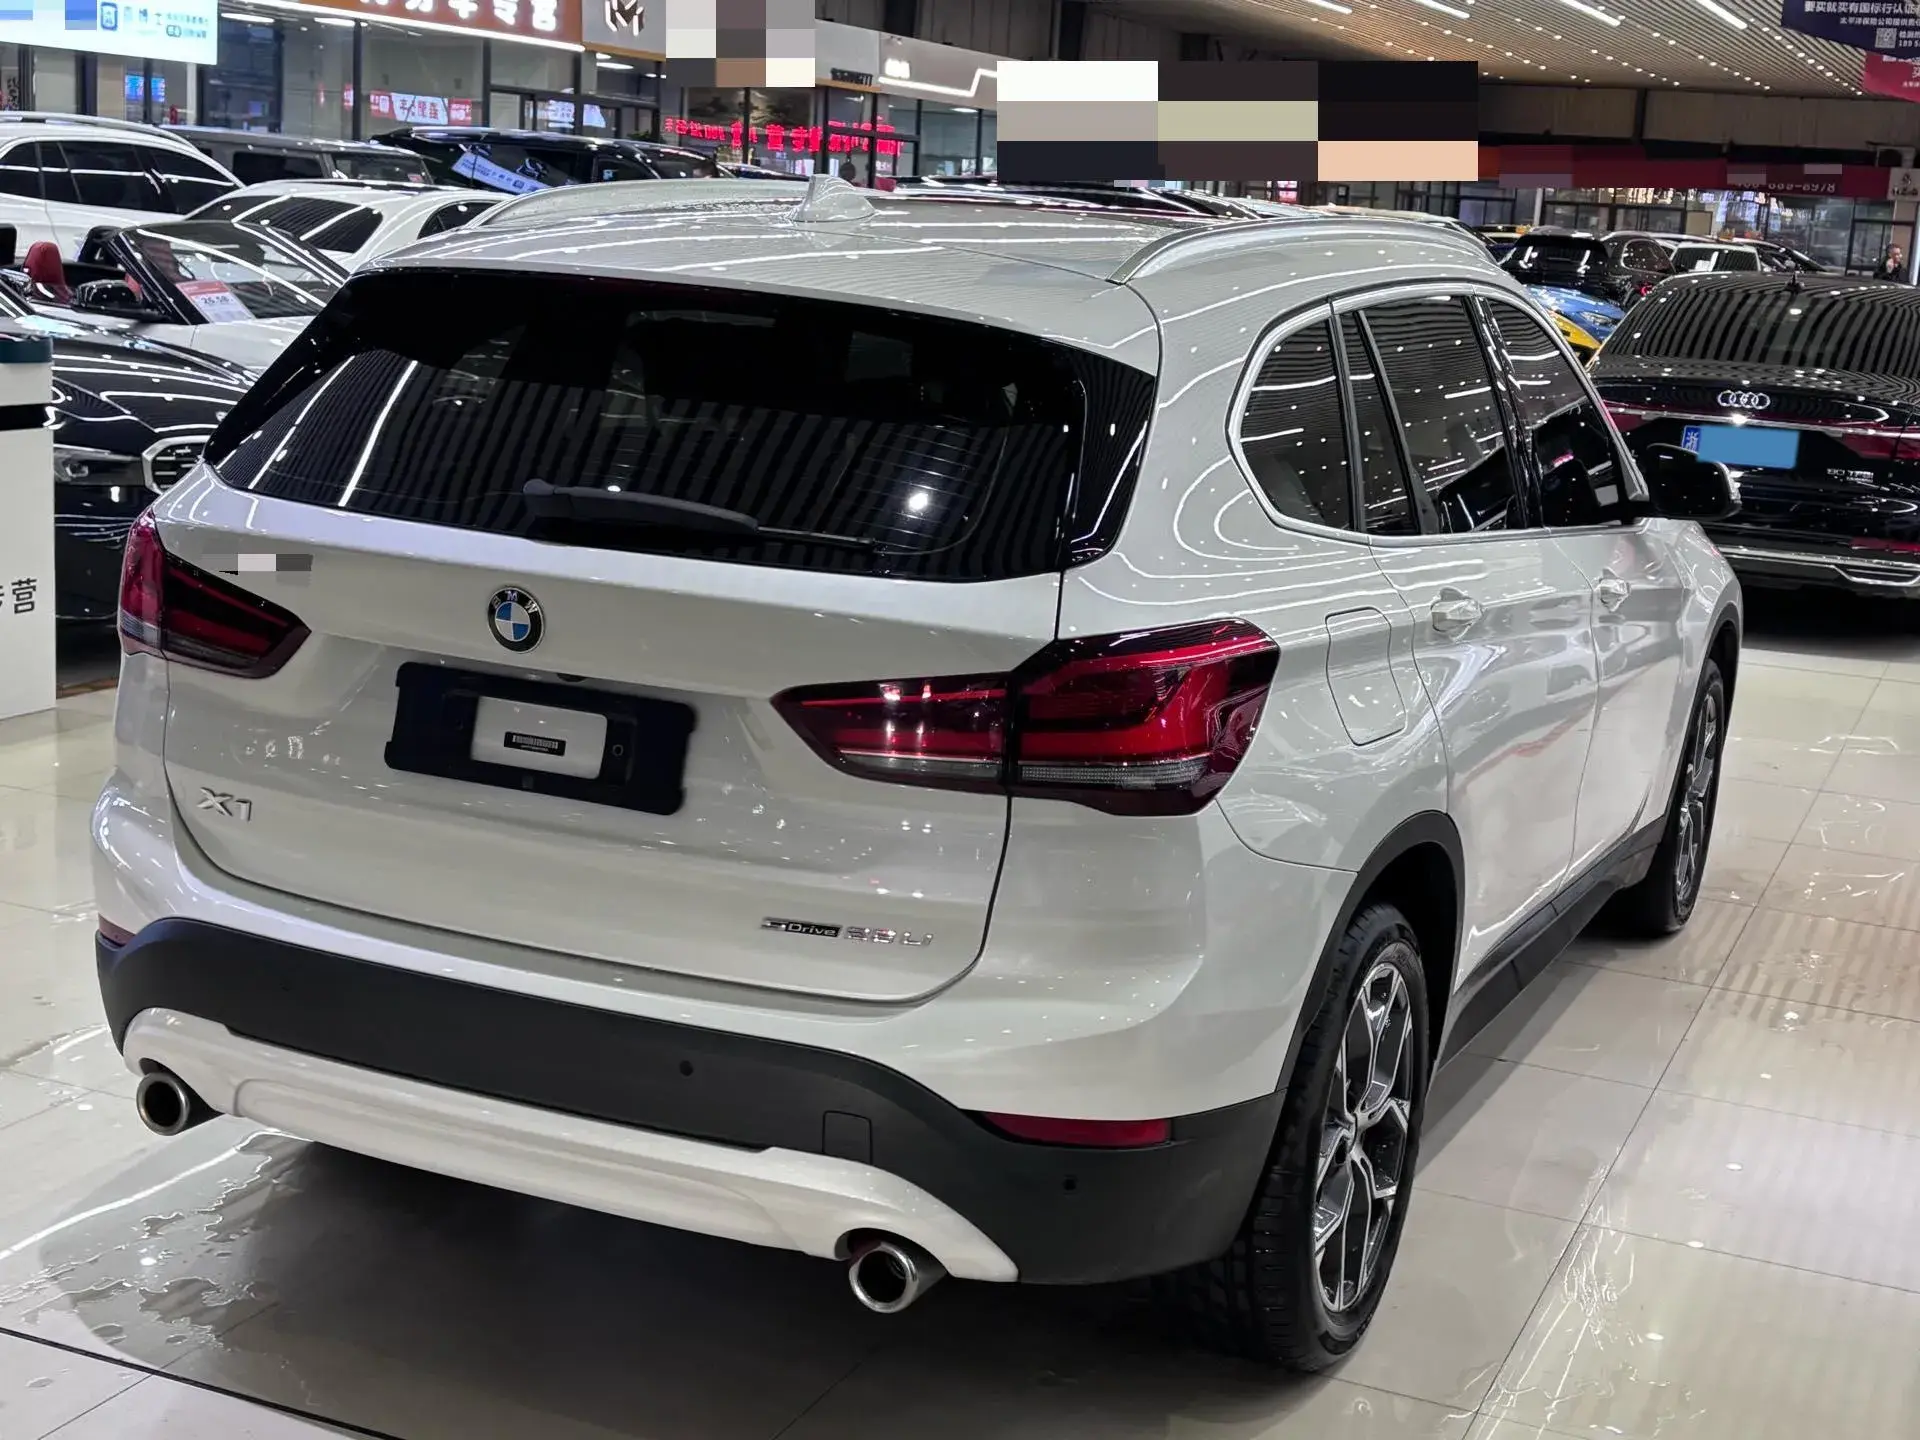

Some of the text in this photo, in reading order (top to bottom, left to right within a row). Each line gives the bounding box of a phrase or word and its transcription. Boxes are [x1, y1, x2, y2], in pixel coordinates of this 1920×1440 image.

[0, 577, 37, 614] 营
[492, 590, 538, 614] BMW
[196, 786, 252, 822] X1
